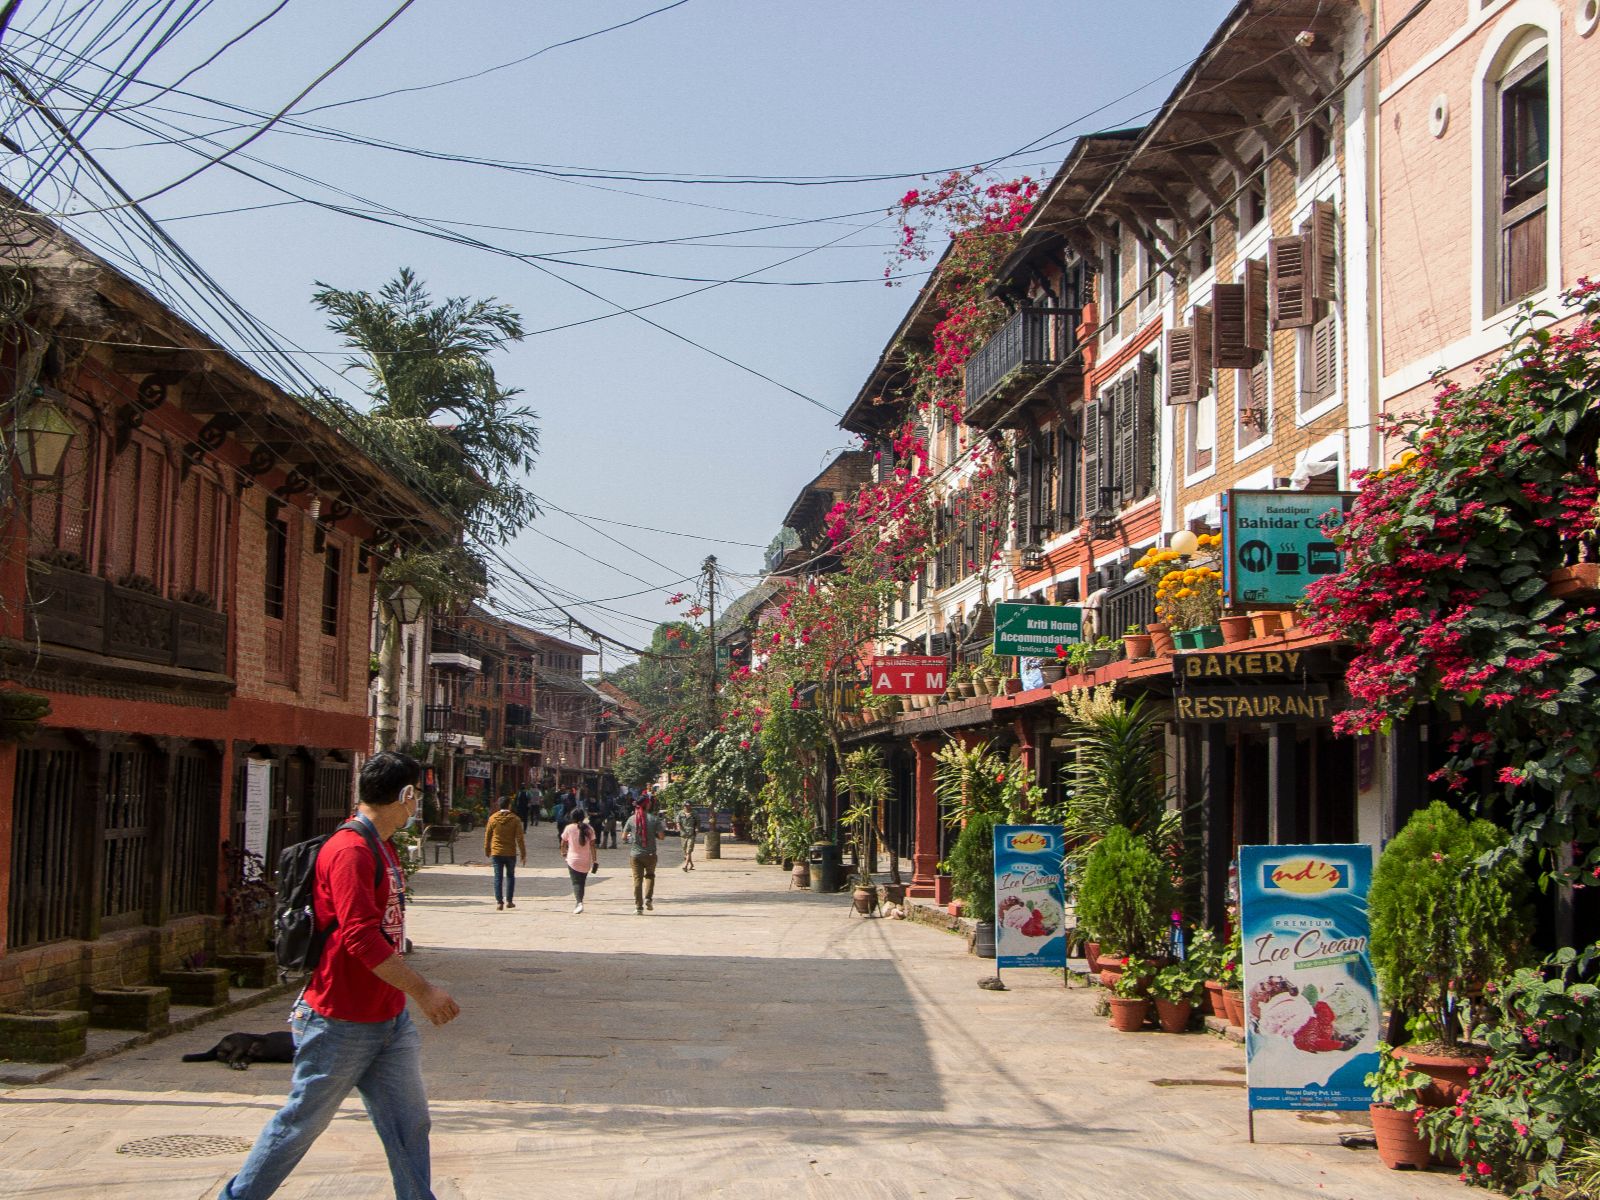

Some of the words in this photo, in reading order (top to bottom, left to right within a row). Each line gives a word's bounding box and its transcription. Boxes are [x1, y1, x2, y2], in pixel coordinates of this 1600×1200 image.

[1266, 506, 1311, 515] Bandipur
[1239, 517, 1300, 529] Bahidar
[1304, 516, 1339, 529] Cafe
[1027, 619, 1048, 629] Kriti
[1050, 620, 1078, 630] Home
[1001, 632, 1079, 644] Accommodation
[1186, 652, 1300, 677] BAKERY
[1177, 695, 1329, 719] RESTAURANT
[999, 872, 1020, 890] Ice
[1022, 870, 1059, 886] Cream
[1271, 861, 1342, 882] nd's
[1250, 933, 1290, 966] Ice
[1294, 929, 1366, 959] Cream
